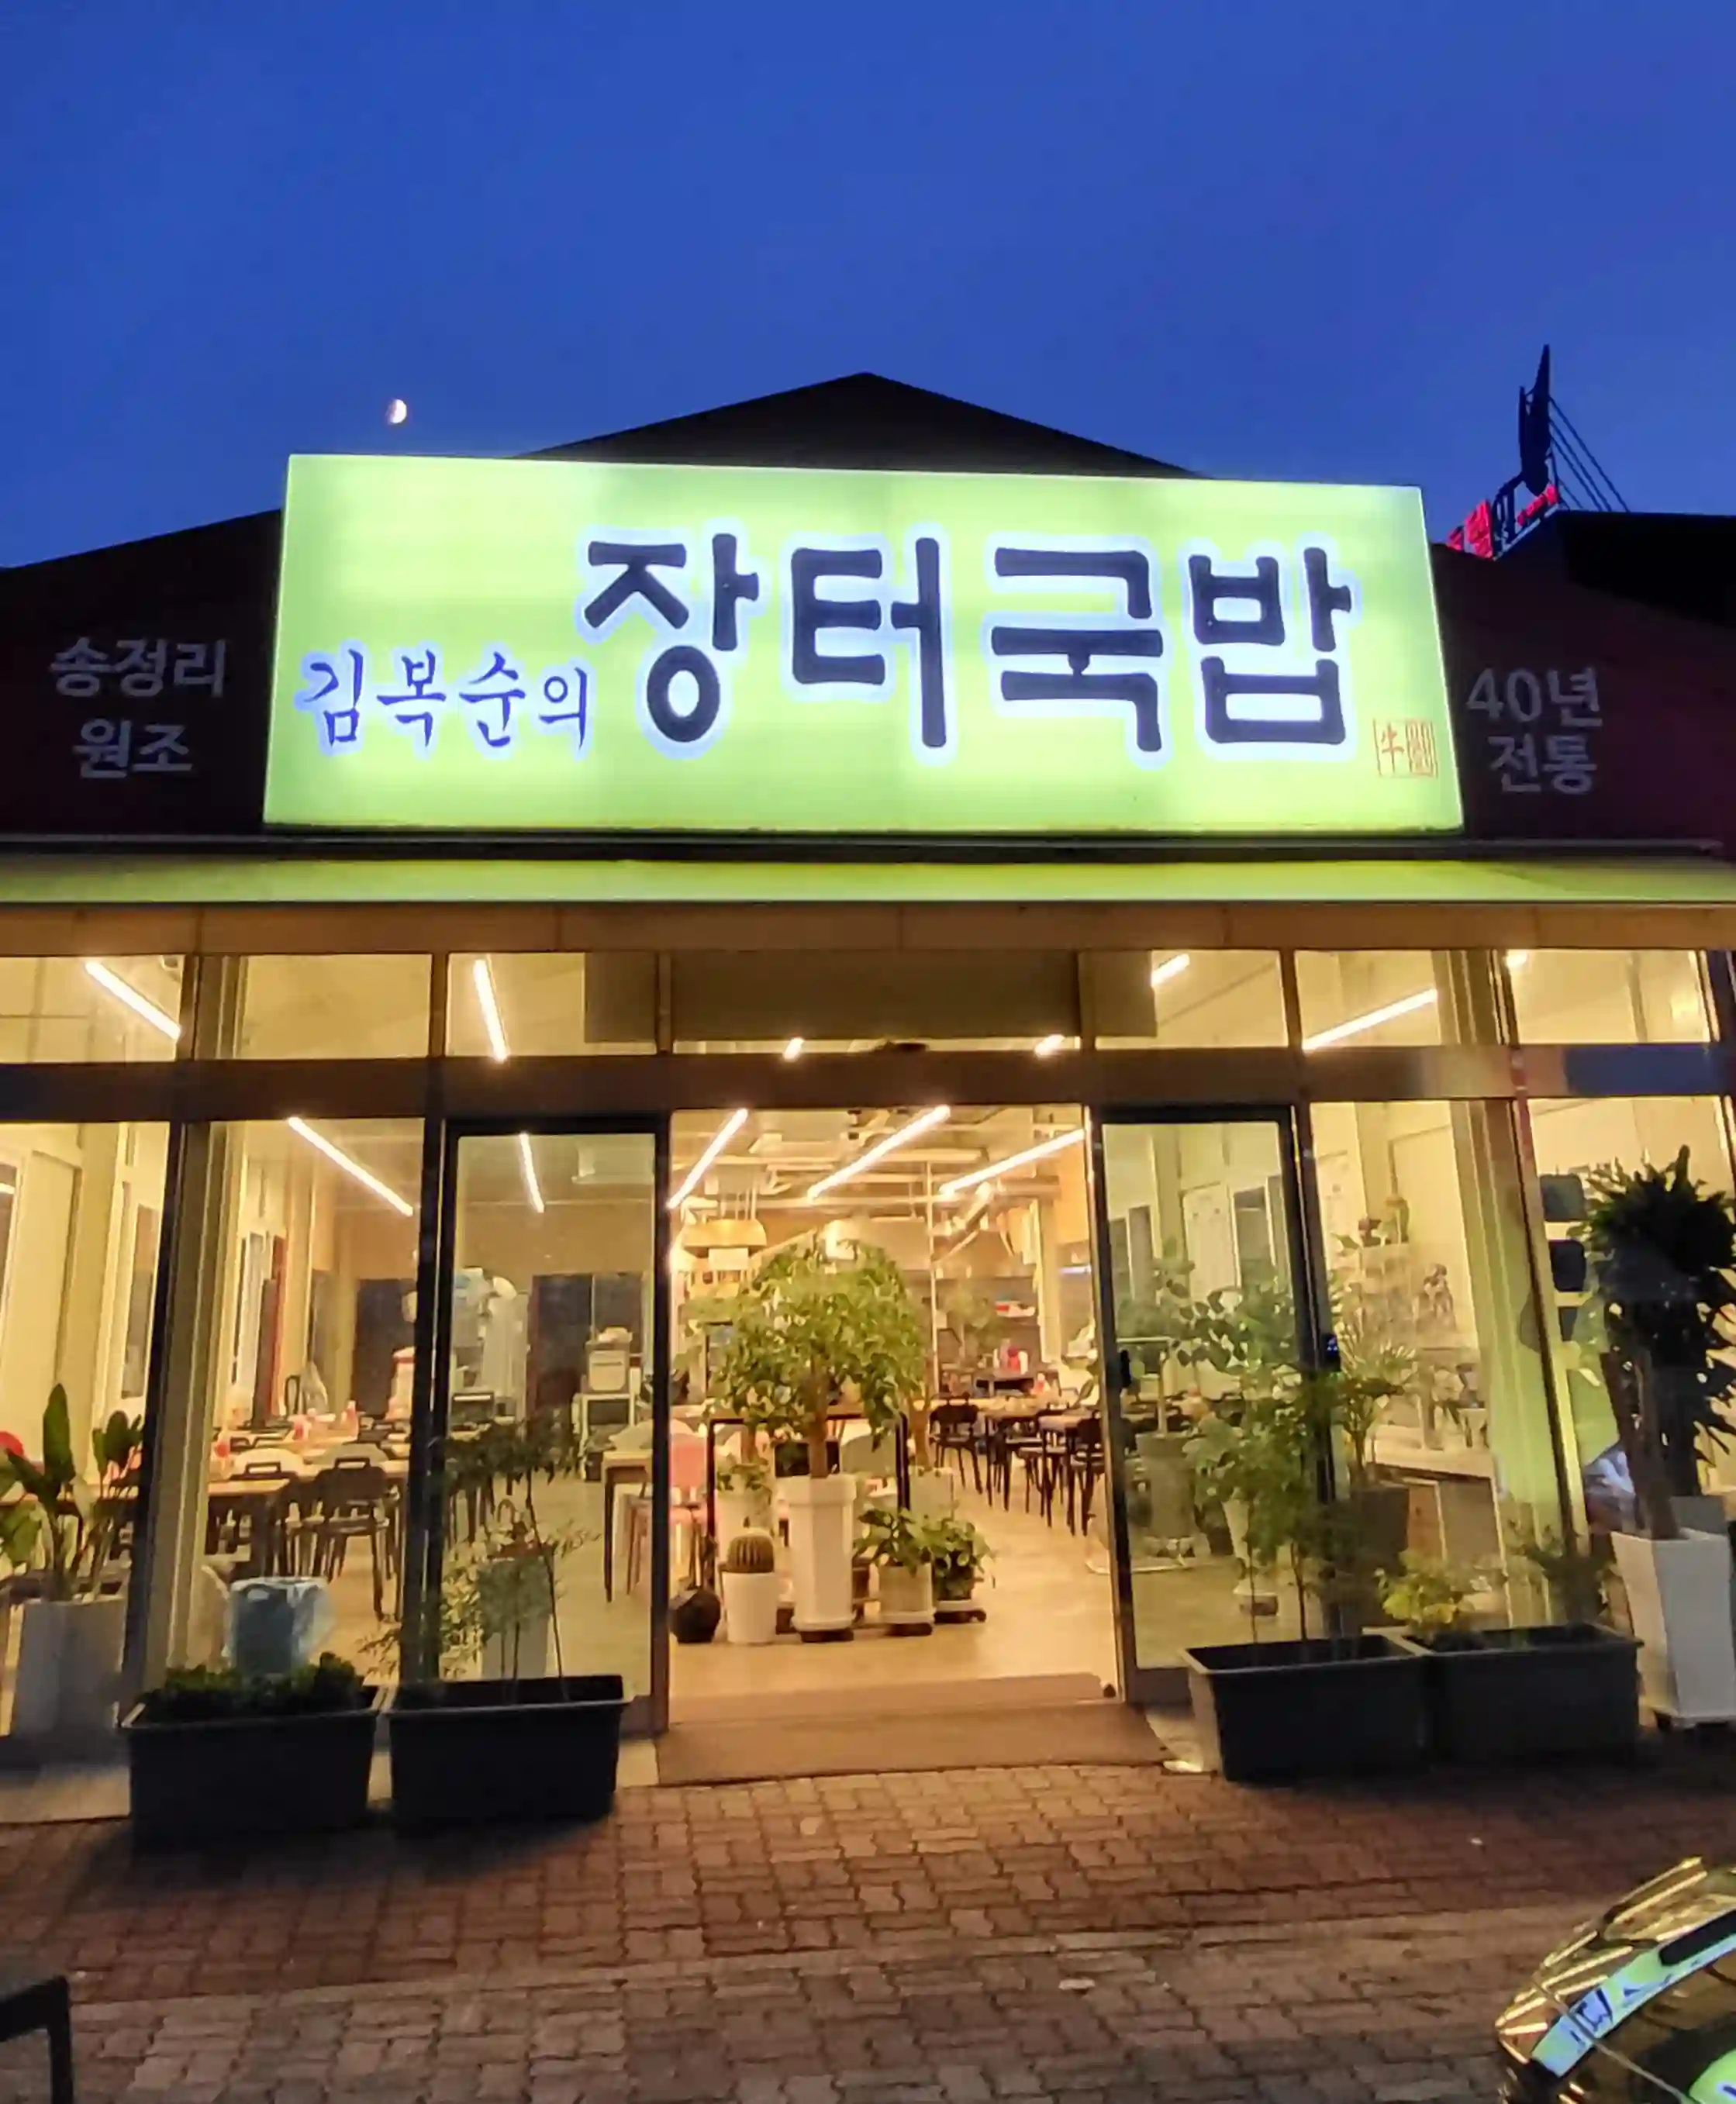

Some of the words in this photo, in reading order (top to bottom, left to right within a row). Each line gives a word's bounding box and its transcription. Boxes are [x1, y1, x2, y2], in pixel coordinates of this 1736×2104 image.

[50, 636, 226, 698] 송정리
[309, 648, 588, 751] 김복순의
[583, 533, 1352, 752] 장터국밥
[1465, 666, 1603, 728] 40년
[72, 717, 194, 779] 원조
[1488, 733, 1598, 795] 전통
